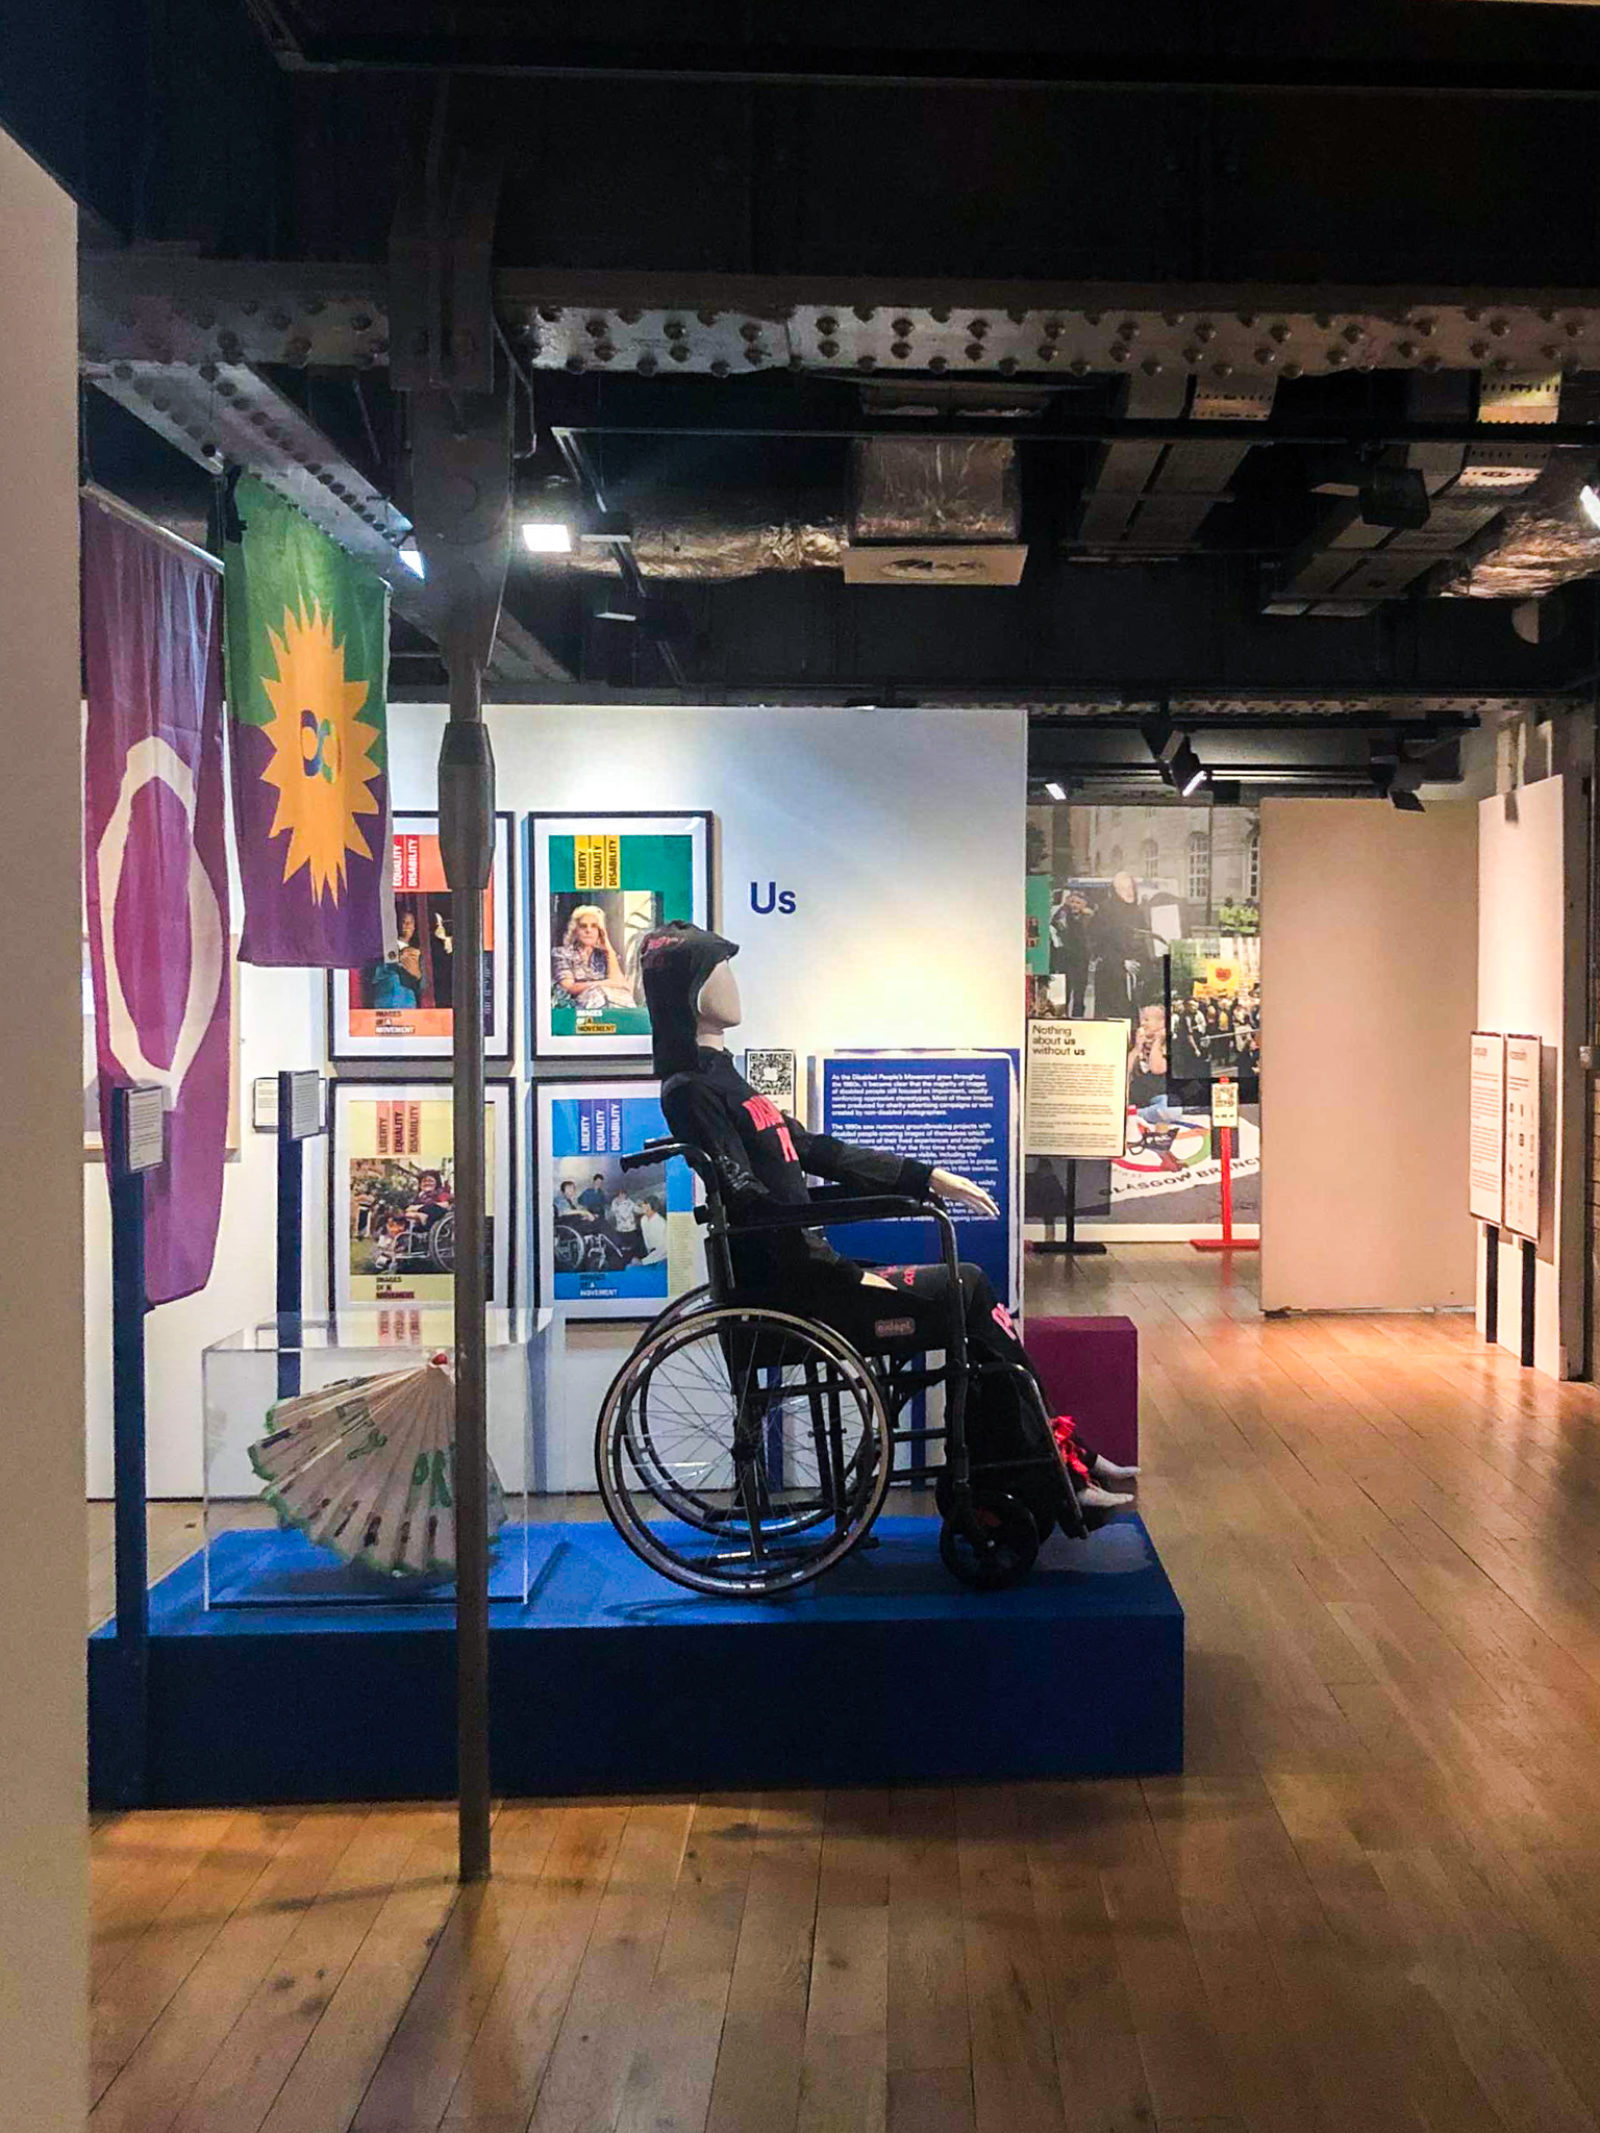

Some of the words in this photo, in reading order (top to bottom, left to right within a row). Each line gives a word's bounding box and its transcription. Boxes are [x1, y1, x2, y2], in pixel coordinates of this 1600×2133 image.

[392, 844, 404, 887] EQUALITY
[408, 838, 418, 886] DISABILITY
[578, 851, 587, 886] LIBERTY
[594, 845, 602, 886] EQUALITY
[609, 840, 618, 886] DISABILITY
[750, 881, 796, 914] Us
[1032, 1024, 1072, 1036] Nothing
[1032, 1036, 1061, 1045] about
[1032, 1046, 1071, 1056] without
[379, 1117, 388, 1153] LIBERTY
[394, 1112, 404, 1152] EQUALITY
[409, 1106, 418, 1153] DISABILITY
[580, 1116, 590, 1152] LIBERTY
[596, 1110, 606, 1152] EQUALITY
[610, 1103, 620, 1151] DISABILITY
